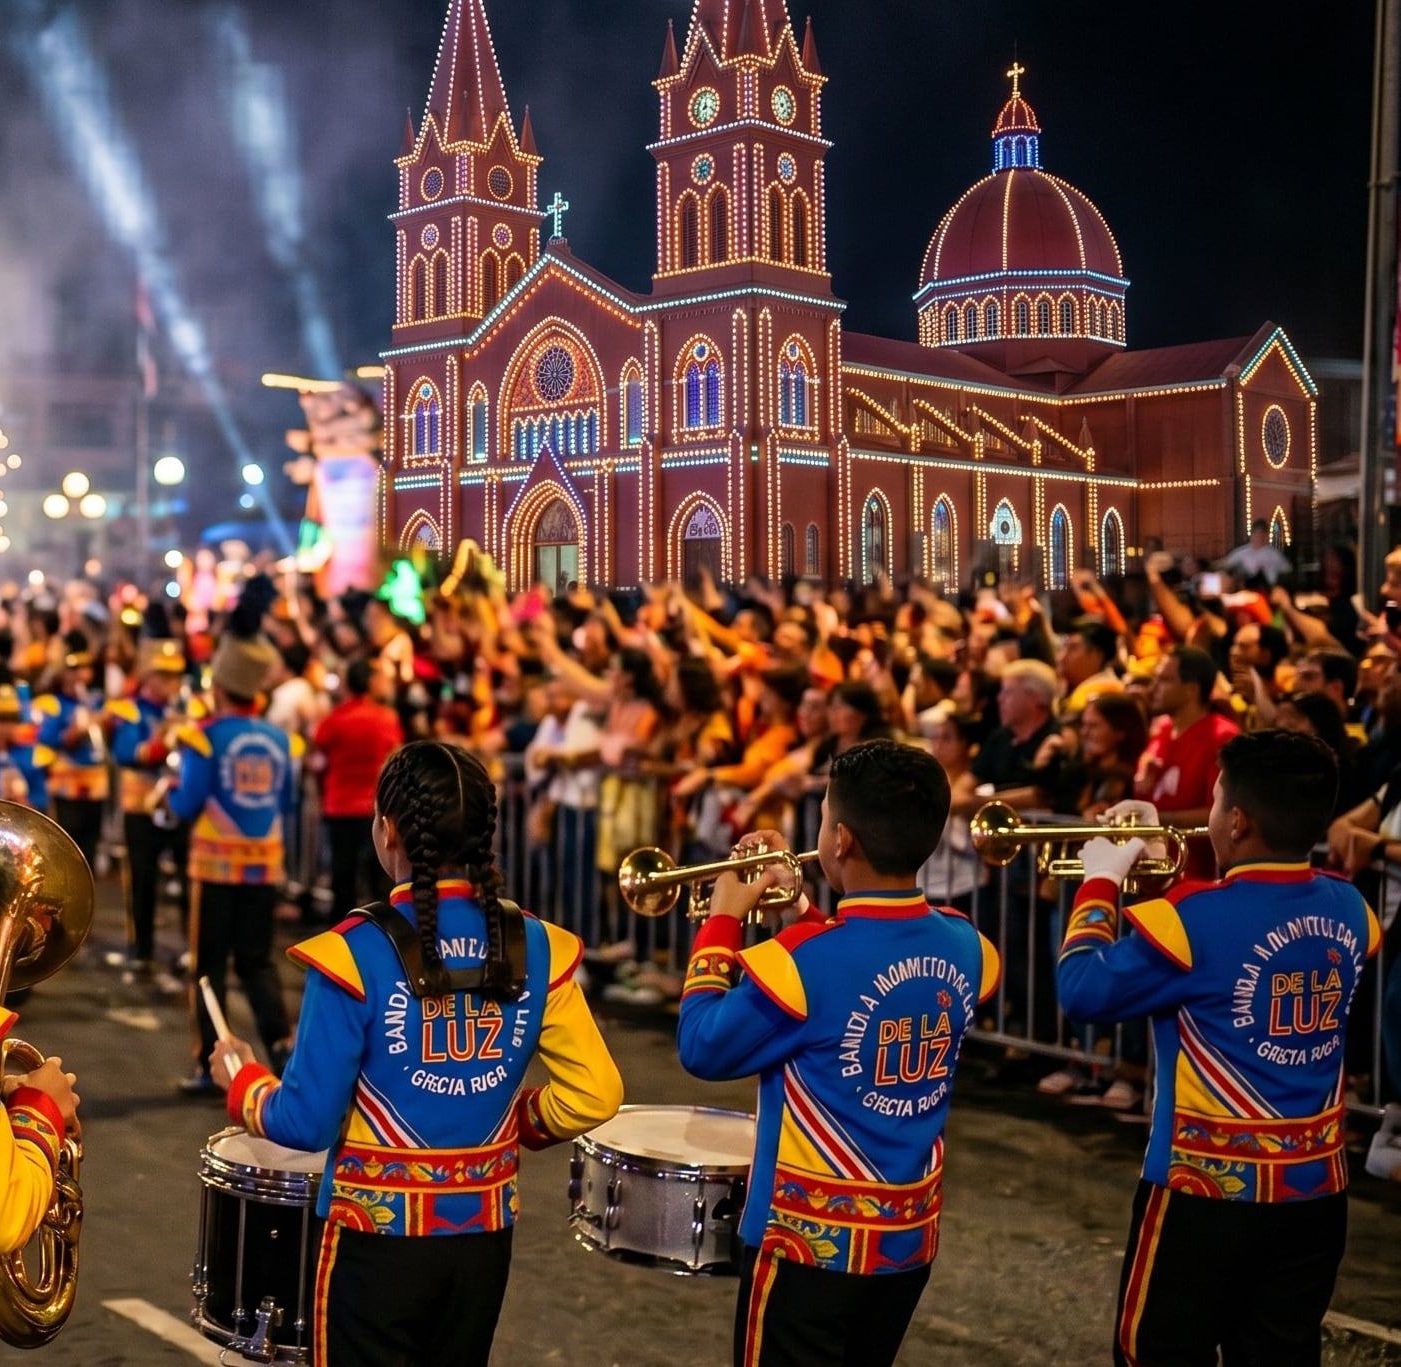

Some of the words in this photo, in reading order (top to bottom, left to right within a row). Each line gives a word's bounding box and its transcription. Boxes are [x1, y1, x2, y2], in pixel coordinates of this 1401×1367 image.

[1271, 971, 1305, 998] DE
[1310, 967, 1343, 992] LA
[422, 993, 456, 1021] DE
[464, 993, 503, 1017] LA
[1268, 990, 1343, 1037] LUZ
[421, 1016, 504, 1063] LUZ
[878, 1016, 913, 1046] DE
[920, 1011, 952, 1039] LA
[874, 1035, 952, 1087] LUZ
